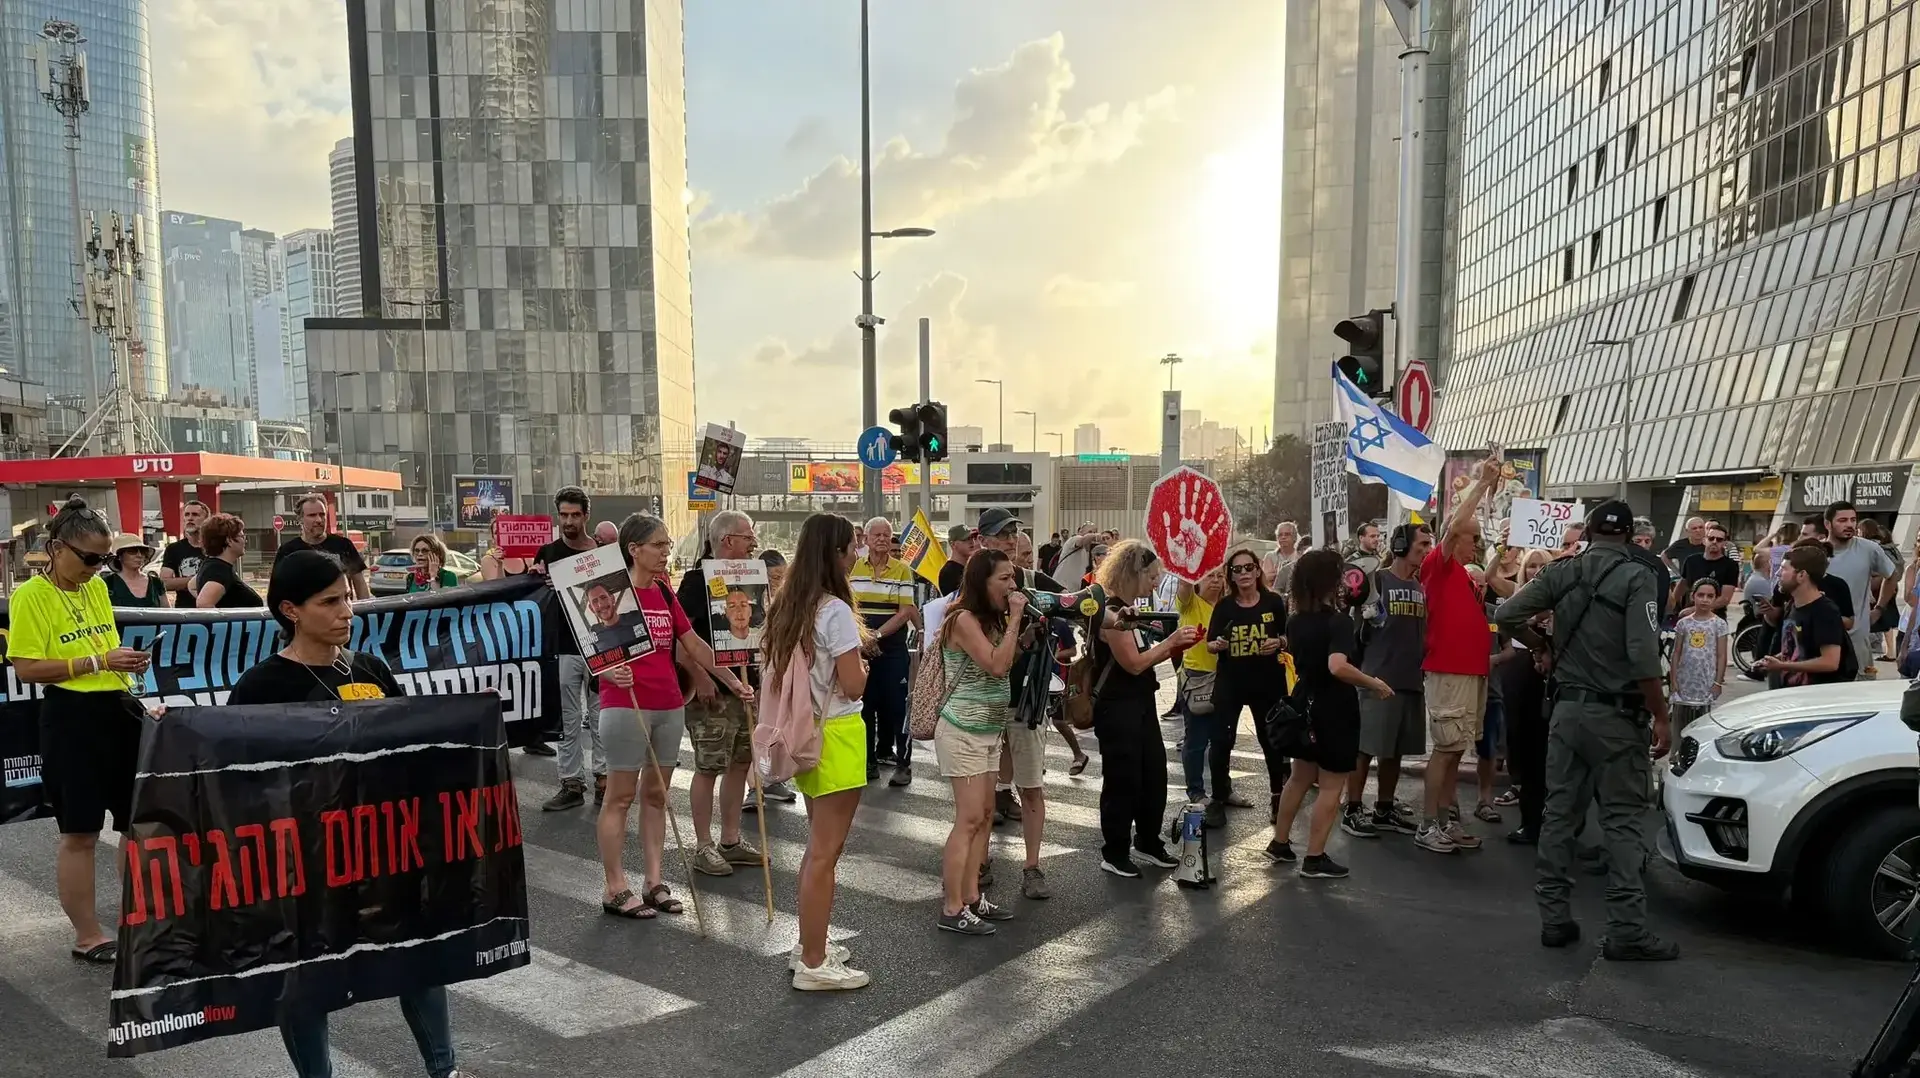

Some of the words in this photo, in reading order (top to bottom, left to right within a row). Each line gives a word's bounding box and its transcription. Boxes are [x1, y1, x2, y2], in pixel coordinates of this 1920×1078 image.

[170, 214, 184, 225] EY
[133, 457, 173, 473] סדש
[1856, 471, 1893, 484] CULTURE
[1803, 473, 1856, 506] SHANY
[1863, 485, 1892, 497] BAKING
[1540, 503, 1574, 520] עזה
[501, 522, 535, 532] החטוף
[537, 522, 550, 532] עד
[1528, 518, 1567, 536] ולטה
[507, 535, 545, 545] האחרון
[1529, 534, 1562, 549] וסית
[1388, 588, 1410, 601] בבית
[400, 600, 542, 670] מחזירים
[1231, 623, 1268, 642] SEAL
[321, 797, 425, 889] אותם
